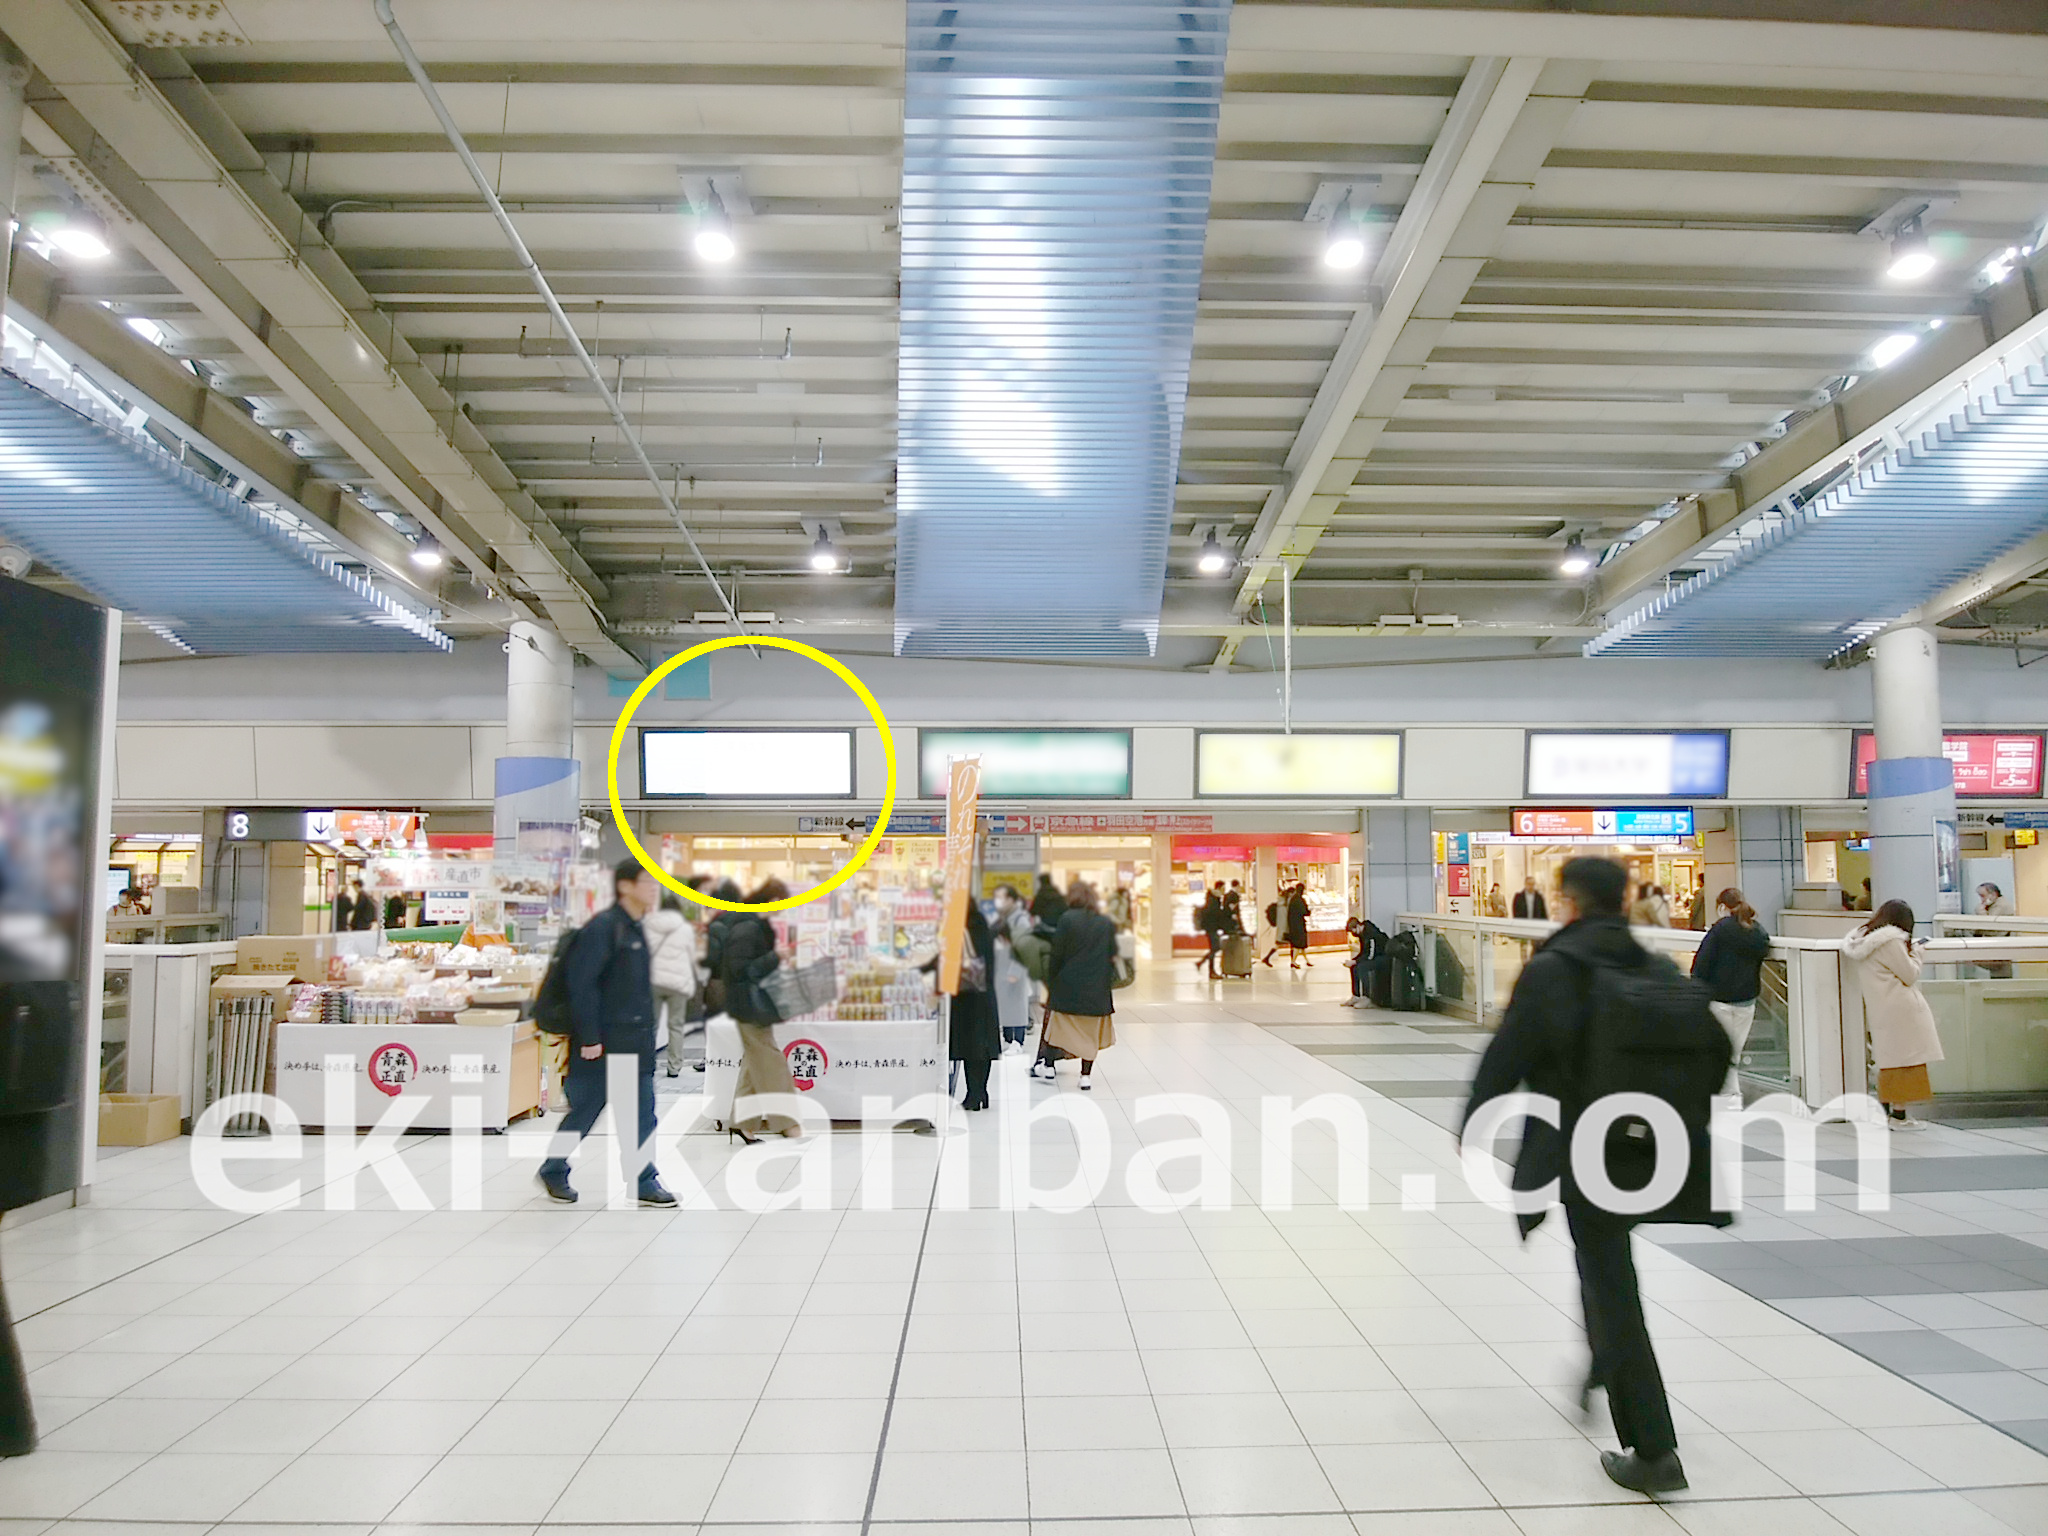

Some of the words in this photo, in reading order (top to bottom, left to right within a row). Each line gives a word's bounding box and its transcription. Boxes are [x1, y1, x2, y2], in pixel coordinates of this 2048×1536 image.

[232, 813, 249, 838] 8
[400, 814, 410, 835] 7
[814, 816, 844, 826] 新幹線
[1049, 816, 1094, 827] 京急線
[1519, 813, 1534, 833] 6
[1675, 813, 1688, 833] 5
[380, 1051, 409, 1067] 青森
[791, 1047, 820, 1062] 青森
[380, 1070, 407, 1083] 正直
[792, 1065, 819, 1079] 正直
